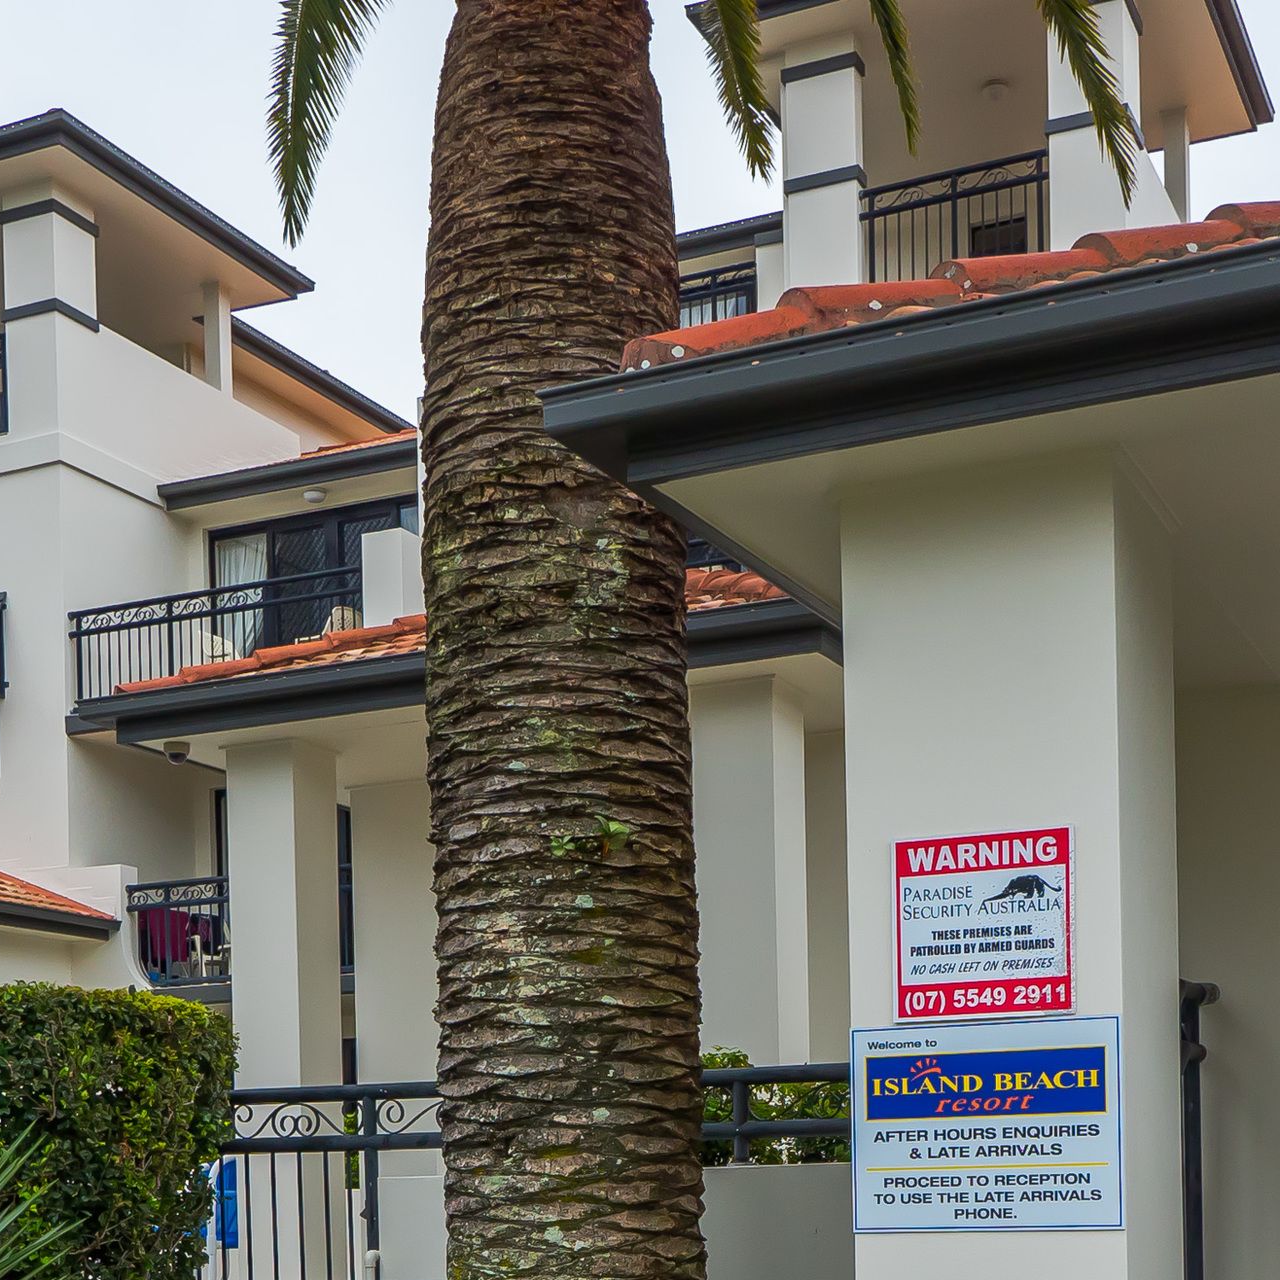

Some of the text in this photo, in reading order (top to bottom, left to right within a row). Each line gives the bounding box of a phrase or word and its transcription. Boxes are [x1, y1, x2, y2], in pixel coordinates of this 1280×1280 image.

[907, 836, 1058, 873] WARNING
[903, 885, 973, 902] PARADISE
[903, 898, 1061, 921] SECURITY AUSTRALIA
[932, 925, 1033, 941] THESE PREMISES ARE
[910, 938, 1055, 957] PATROLLED BY ARMED GUARDS
[910, 957, 1055, 976] NO CASH LEFT ON PREMISES
[904, 983, 1066, 1015] (07) 5549 2911
[867, 1039, 938, 1050] Welcome to
[872, 1069, 1100, 1097] ISLAND BEACH
[934, 1094, 1035, 1113] resort
[873, 1123, 1101, 1143] AFTER HOURS ENQUIRIES
[909, 1143, 1063, 1160] & LATE ARRIVALS
[883, 1173, 1091, 1189] PROCEED TO RECEPTION
[874, 1189, 1103, 1205] TO USE THE LATE ARRIVALS
[954, 1208, 1018, 1220] PHONE.
